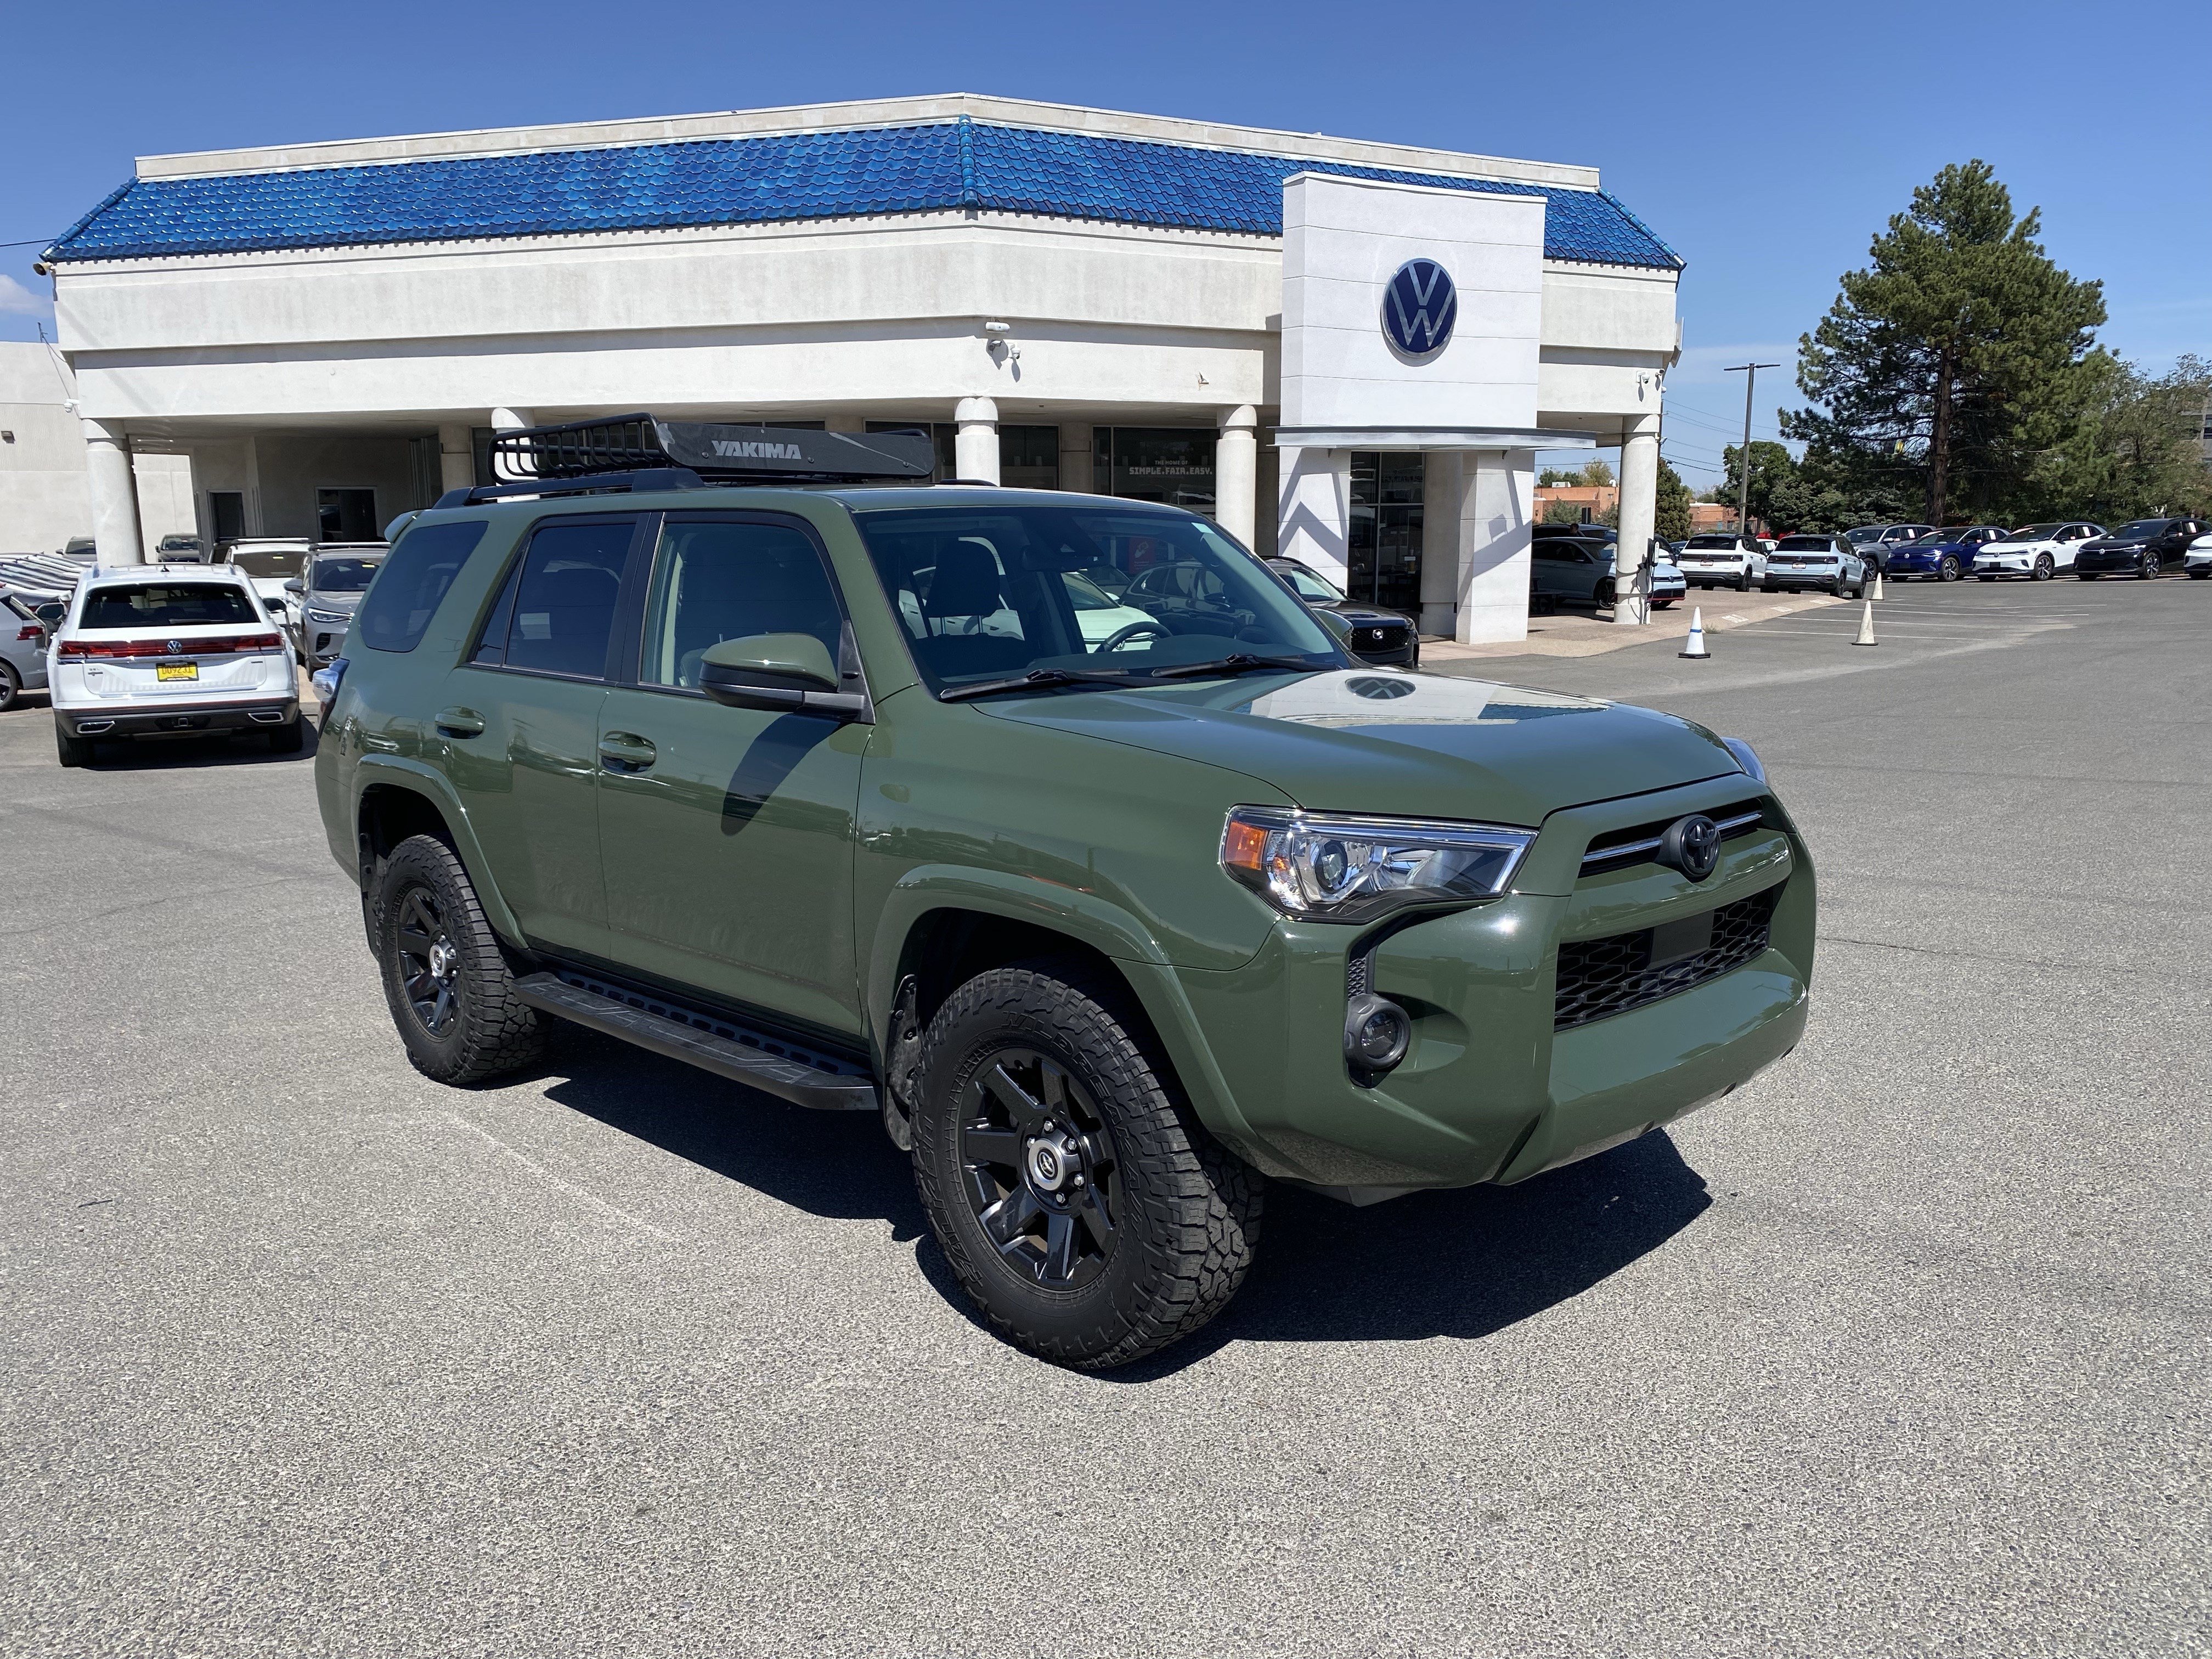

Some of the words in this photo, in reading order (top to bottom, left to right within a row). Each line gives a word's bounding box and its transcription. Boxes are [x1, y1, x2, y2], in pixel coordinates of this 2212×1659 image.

[1383, 258, 1457, 356] VW
[712, 440, 802, 459] YAKIMA
[1001, 1012, 1135, 1157] WILDPEAK
